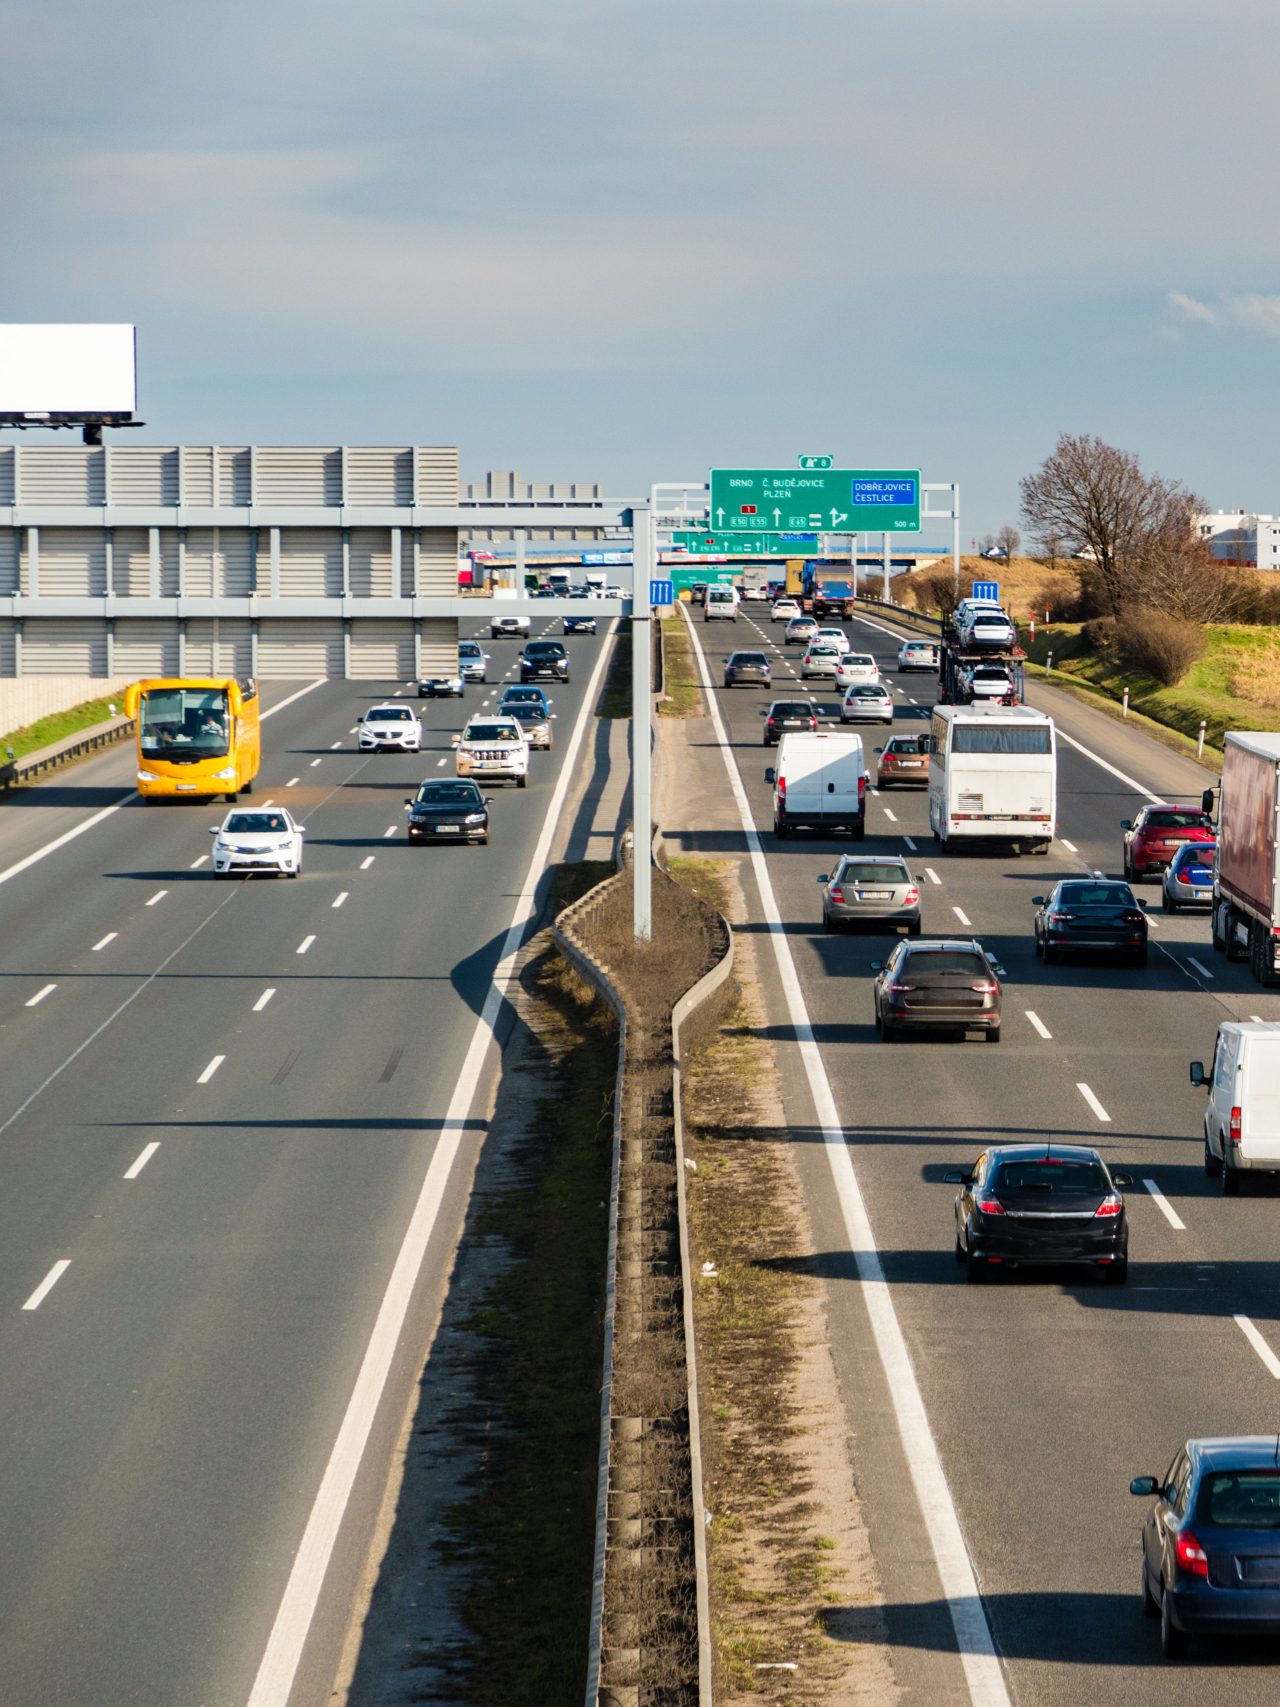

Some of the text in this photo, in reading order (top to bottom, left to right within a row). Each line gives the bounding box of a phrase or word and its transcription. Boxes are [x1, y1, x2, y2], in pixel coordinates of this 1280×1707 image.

[821, 459, 827, 467] 8
[730, 479, 753, 487] BRNO
[763, 478, 825, 487] Č. BUDĚJOVICE
[855, 483, 912, 491] DOBŘEJOVICE
[763, 489, 791, 498] PLZEŇ
[855, 493, 895, 502] ČESTLICE
